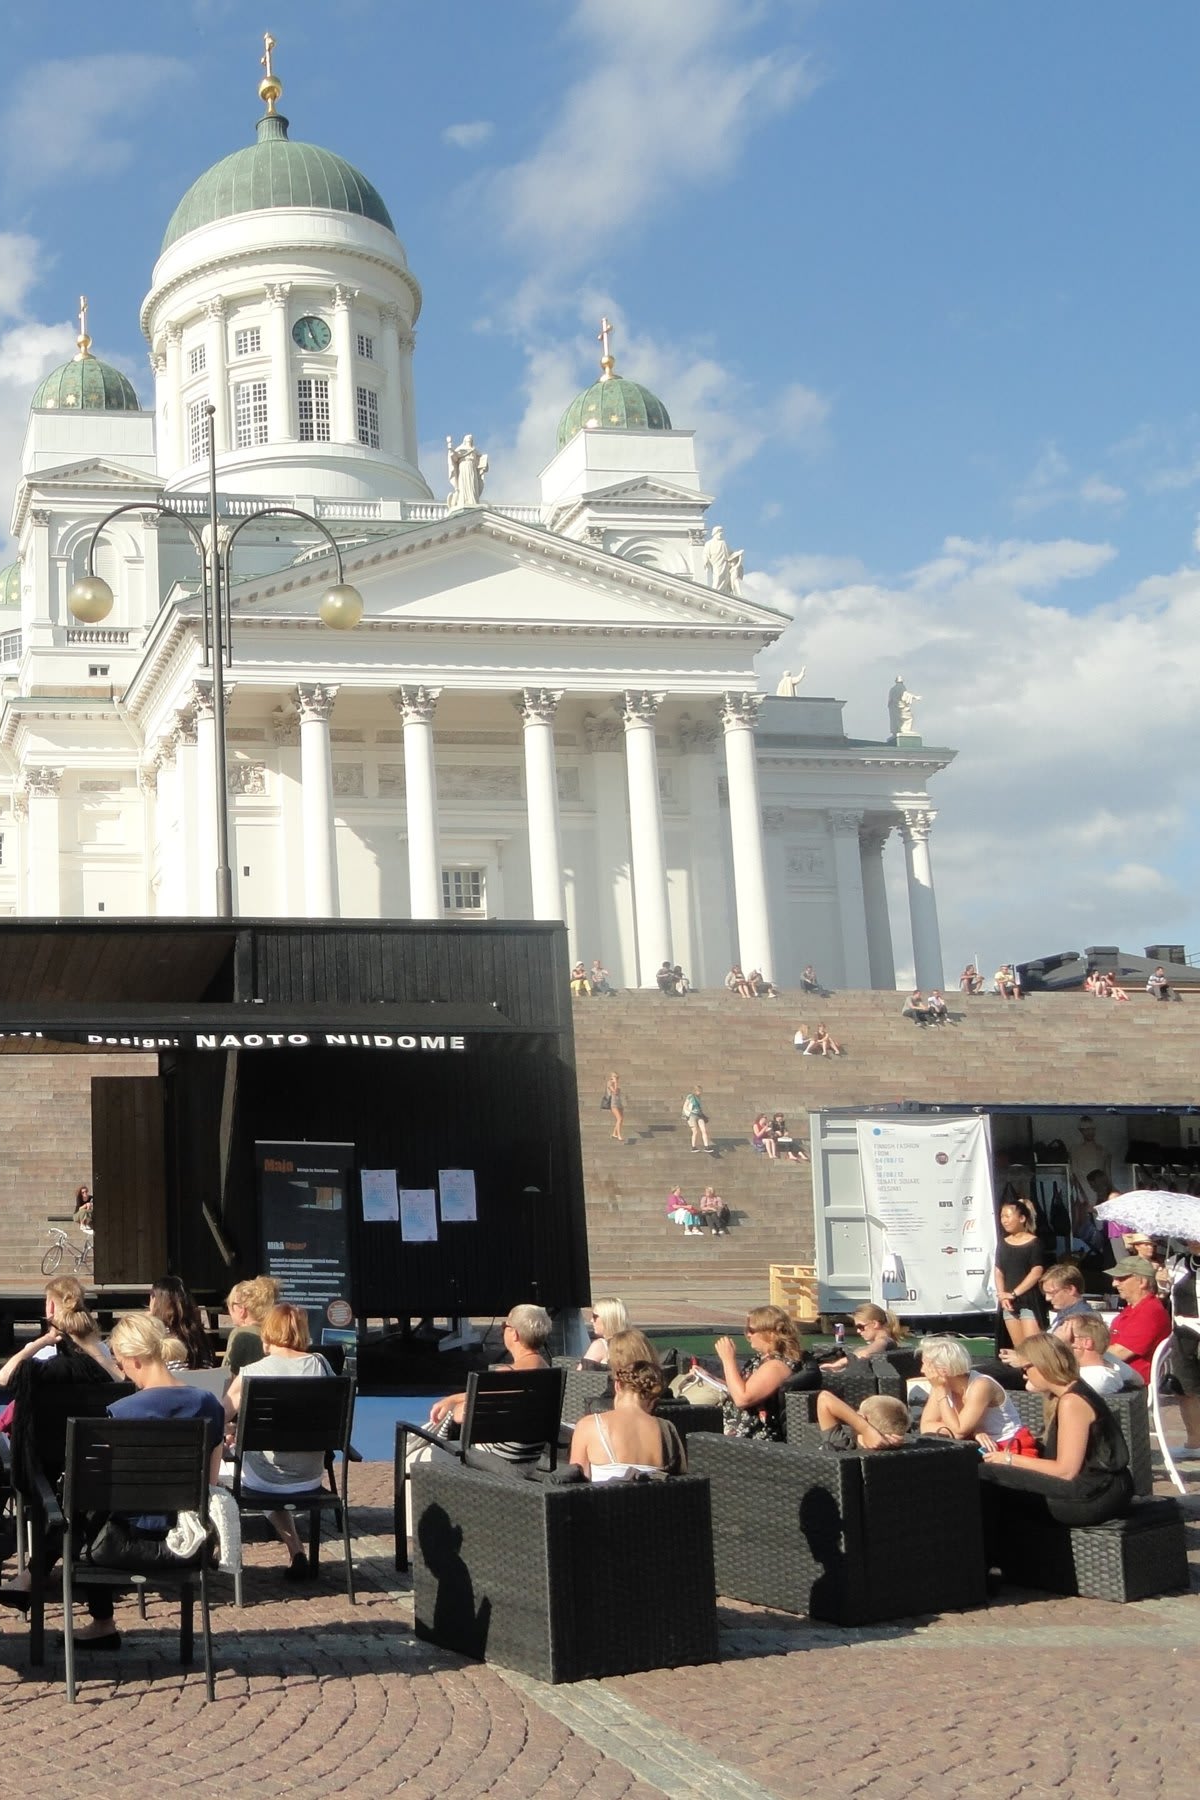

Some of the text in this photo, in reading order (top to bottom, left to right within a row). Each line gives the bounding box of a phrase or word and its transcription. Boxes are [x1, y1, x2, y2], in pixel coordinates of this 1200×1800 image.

[87, 1034, 465, 1049] Design: NAOTO NIIDOME
